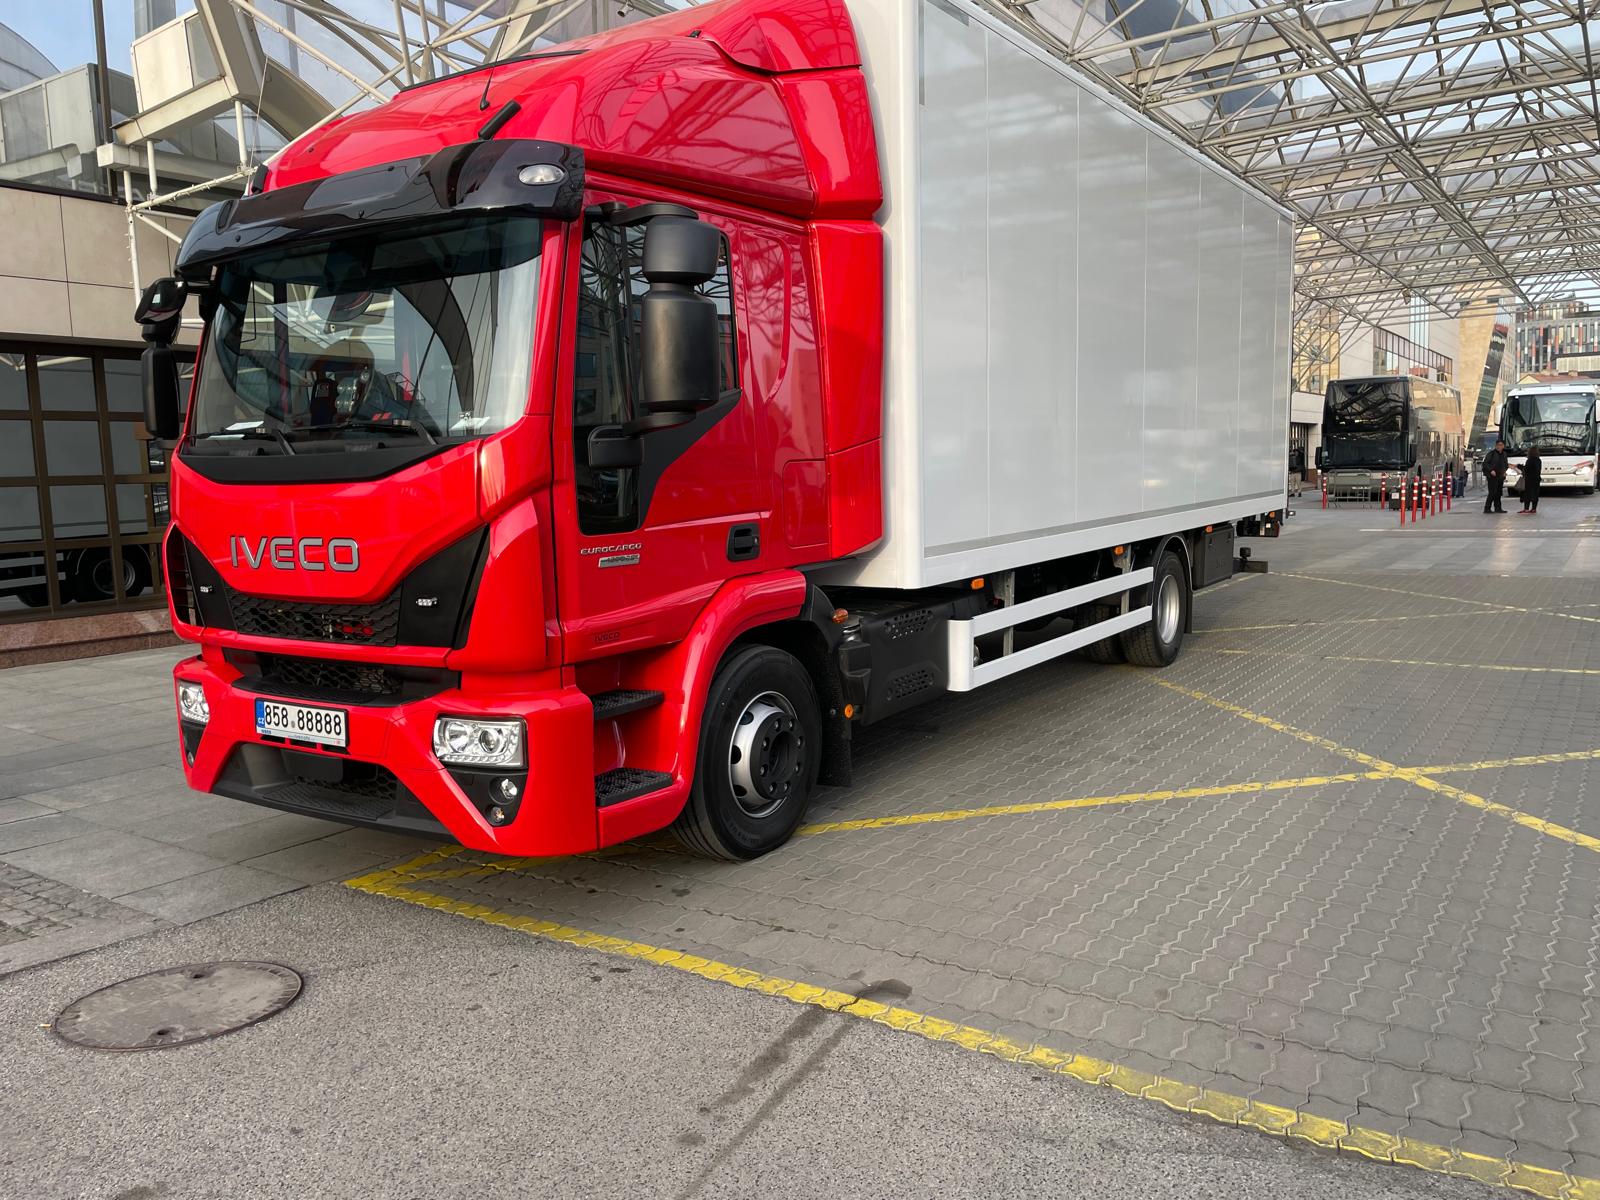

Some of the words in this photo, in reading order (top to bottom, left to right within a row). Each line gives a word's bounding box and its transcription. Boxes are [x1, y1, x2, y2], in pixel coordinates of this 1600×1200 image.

[230, 536, 360, 572] IVECO
[580, 543, 642, 554] EUROCARGO
[258, 717, 265, 725] CZ
[265, 704, 289, 728] 858
[297, 709, 342, 736] 88888
